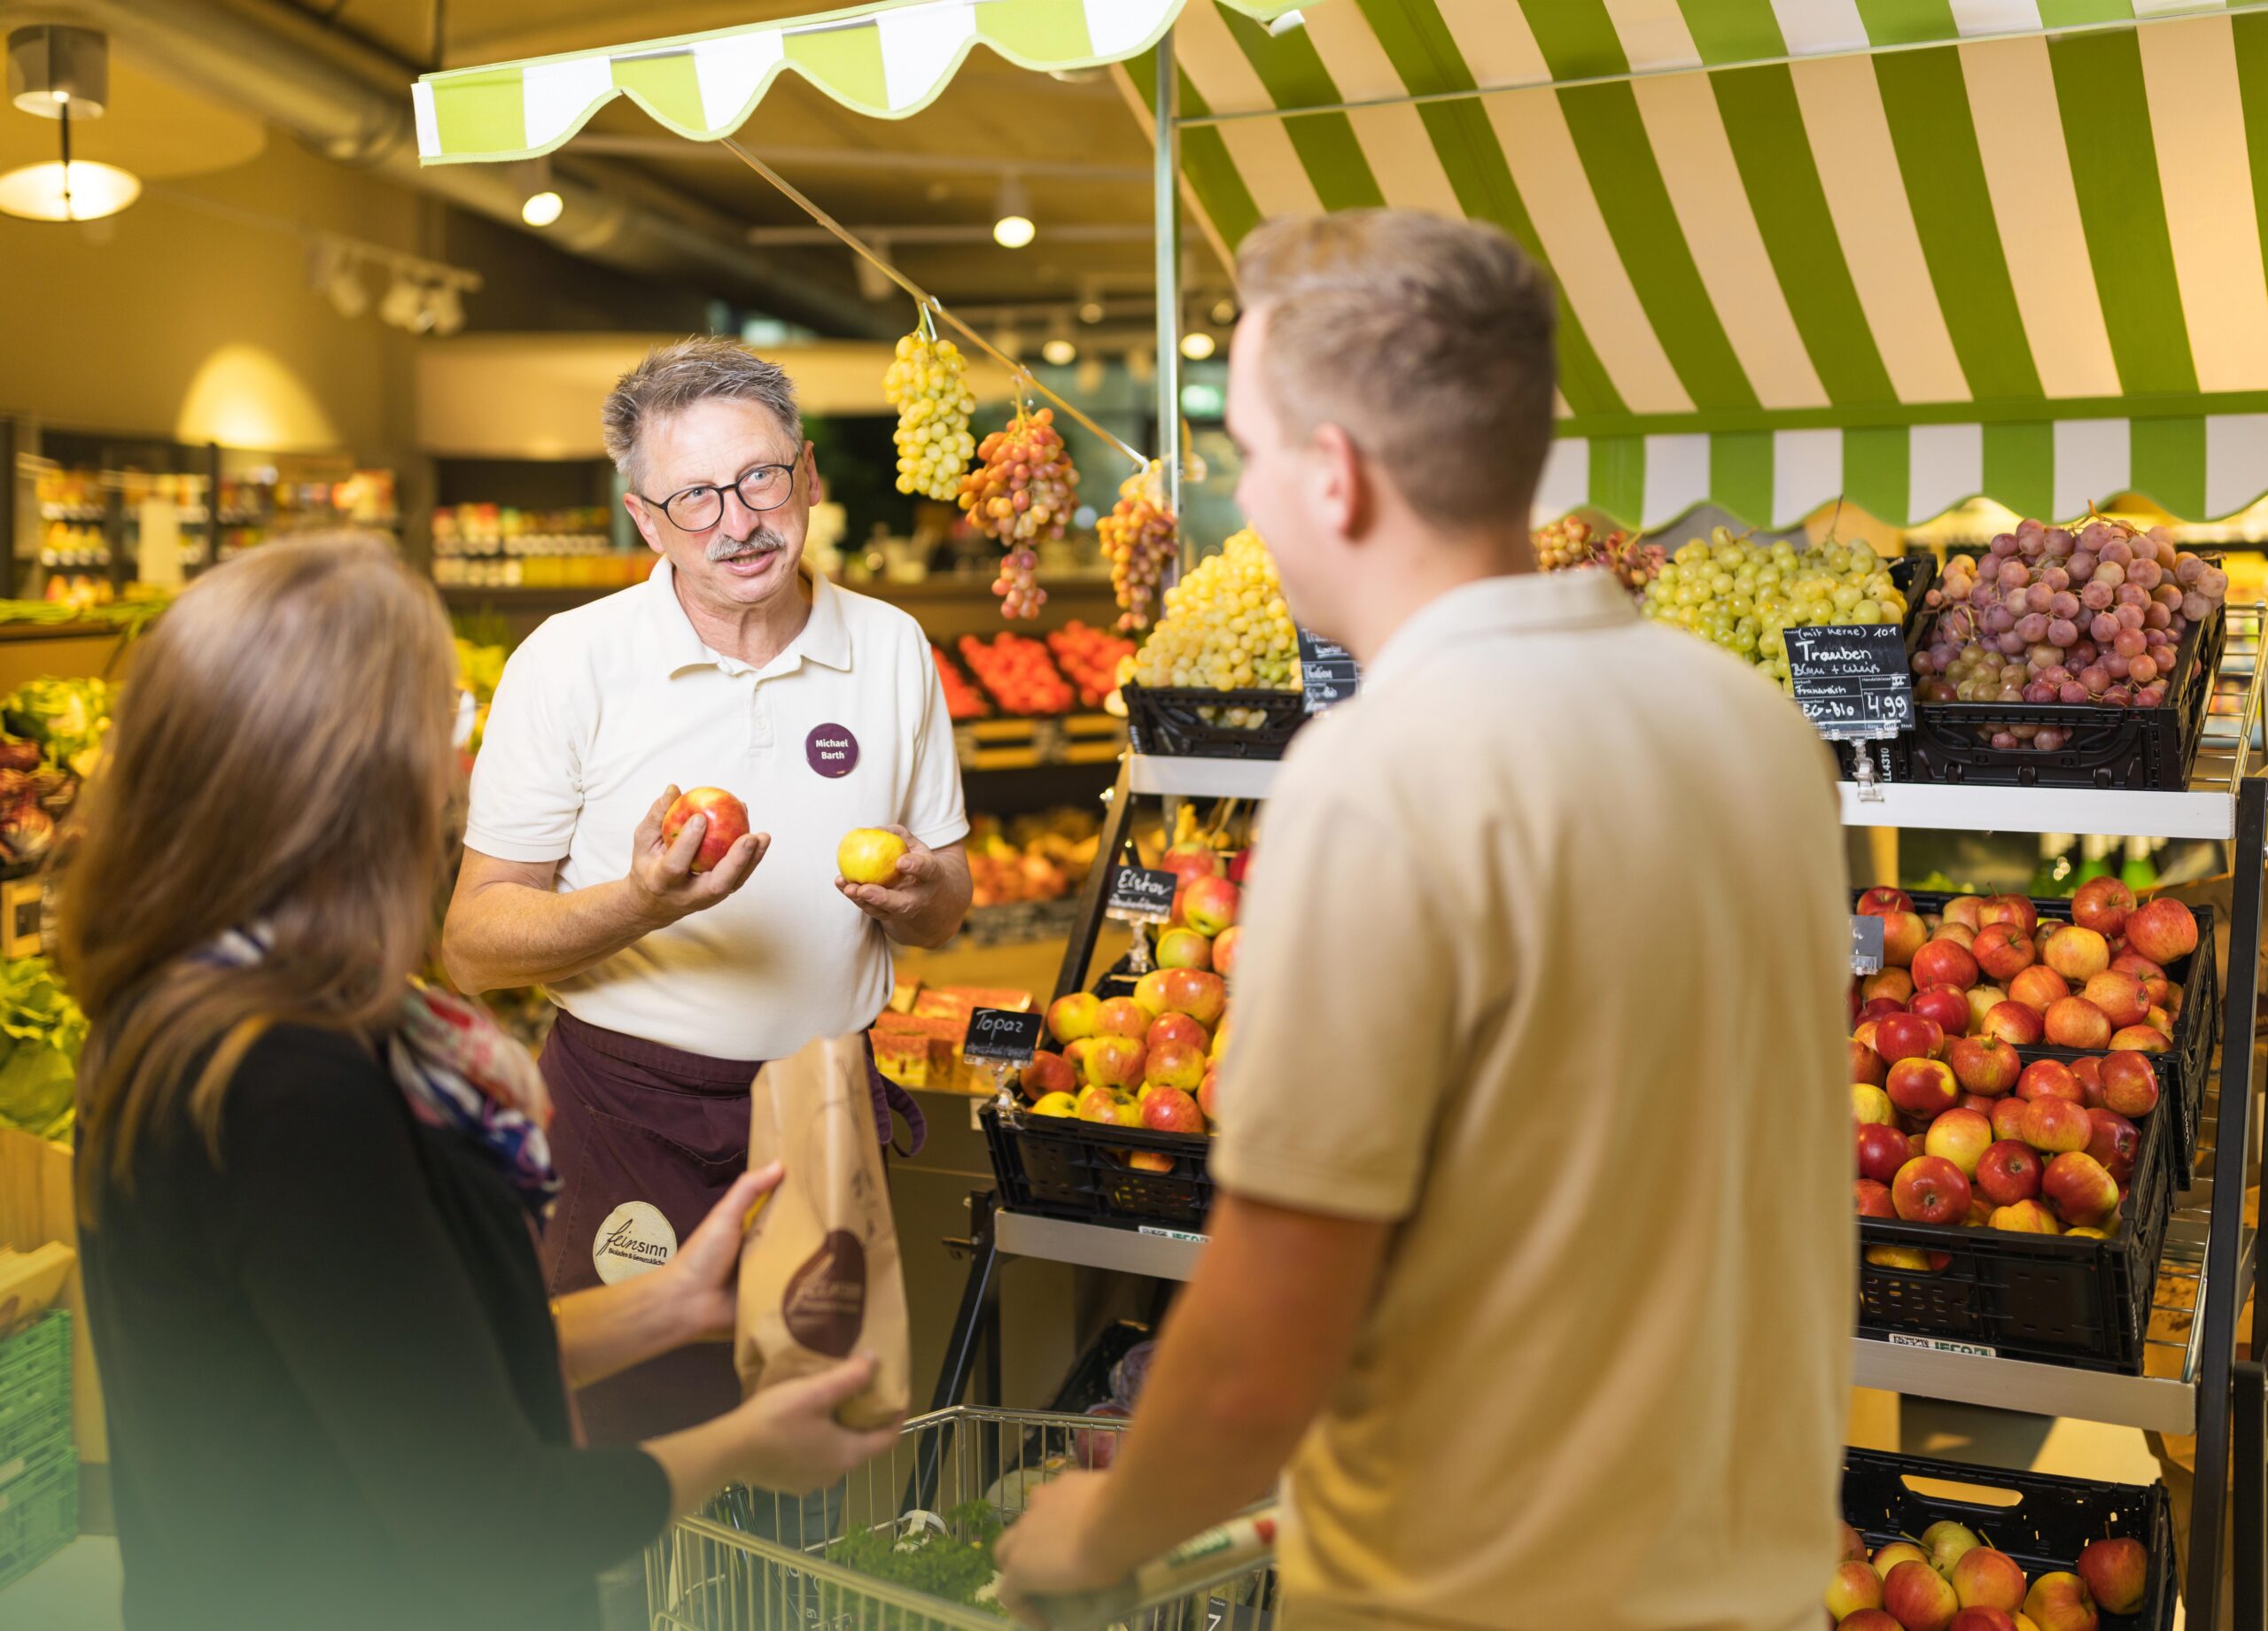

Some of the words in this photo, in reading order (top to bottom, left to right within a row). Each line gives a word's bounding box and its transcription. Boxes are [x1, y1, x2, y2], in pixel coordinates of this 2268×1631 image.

[1798, 627, 1821, 640] (mit
[1873, 626, 1896, 637] 101
[1795, 640, 1872, 662] Trauben
[976, 1010, 1023, 1041] Topaz
